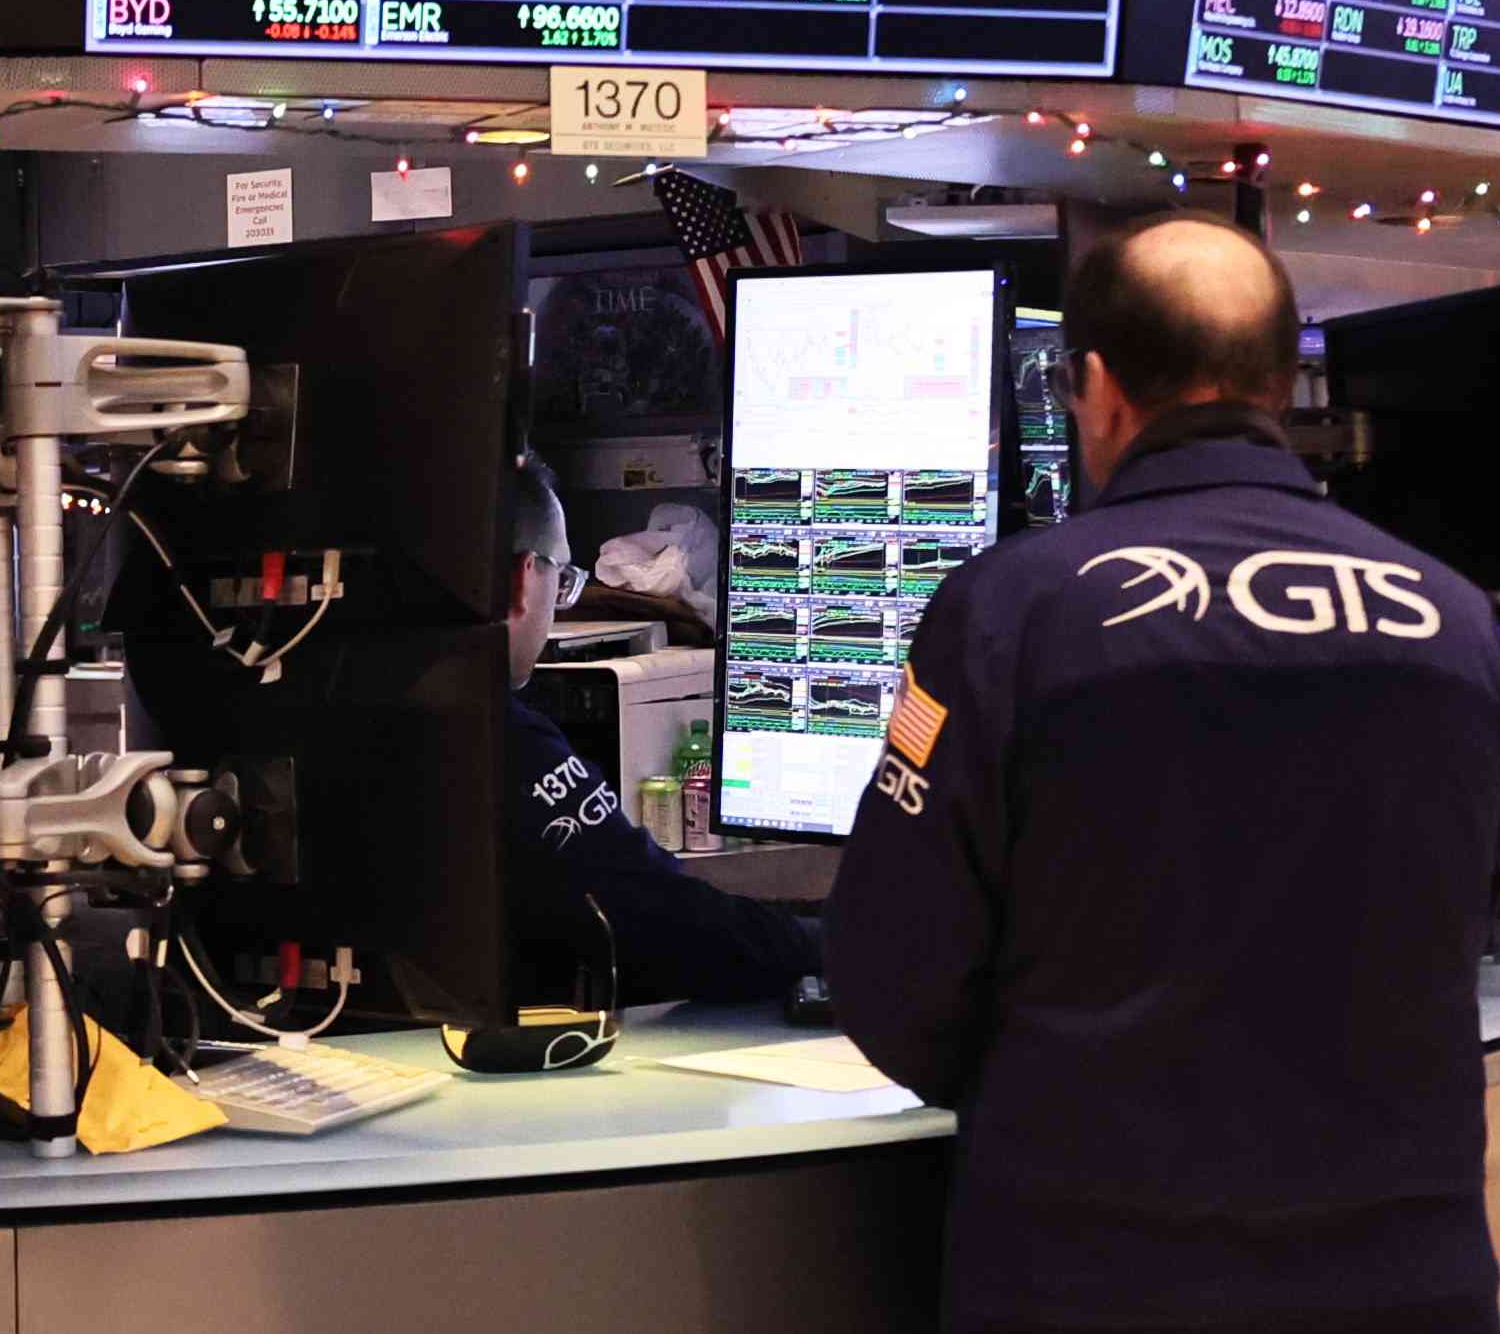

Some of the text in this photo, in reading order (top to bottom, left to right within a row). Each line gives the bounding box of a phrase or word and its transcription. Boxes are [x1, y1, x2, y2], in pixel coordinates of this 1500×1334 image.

[380, 0, 441, 32] EMR
[576, 79, 682, 120] 1370
[593, 286, 655, 313] TIME
[1227, 548, 1441, 639] GTS
[531, 754, 591, 810] 1370
[577, 779, 620, 828] GTS
[876, 753, 930, 816] GTS
